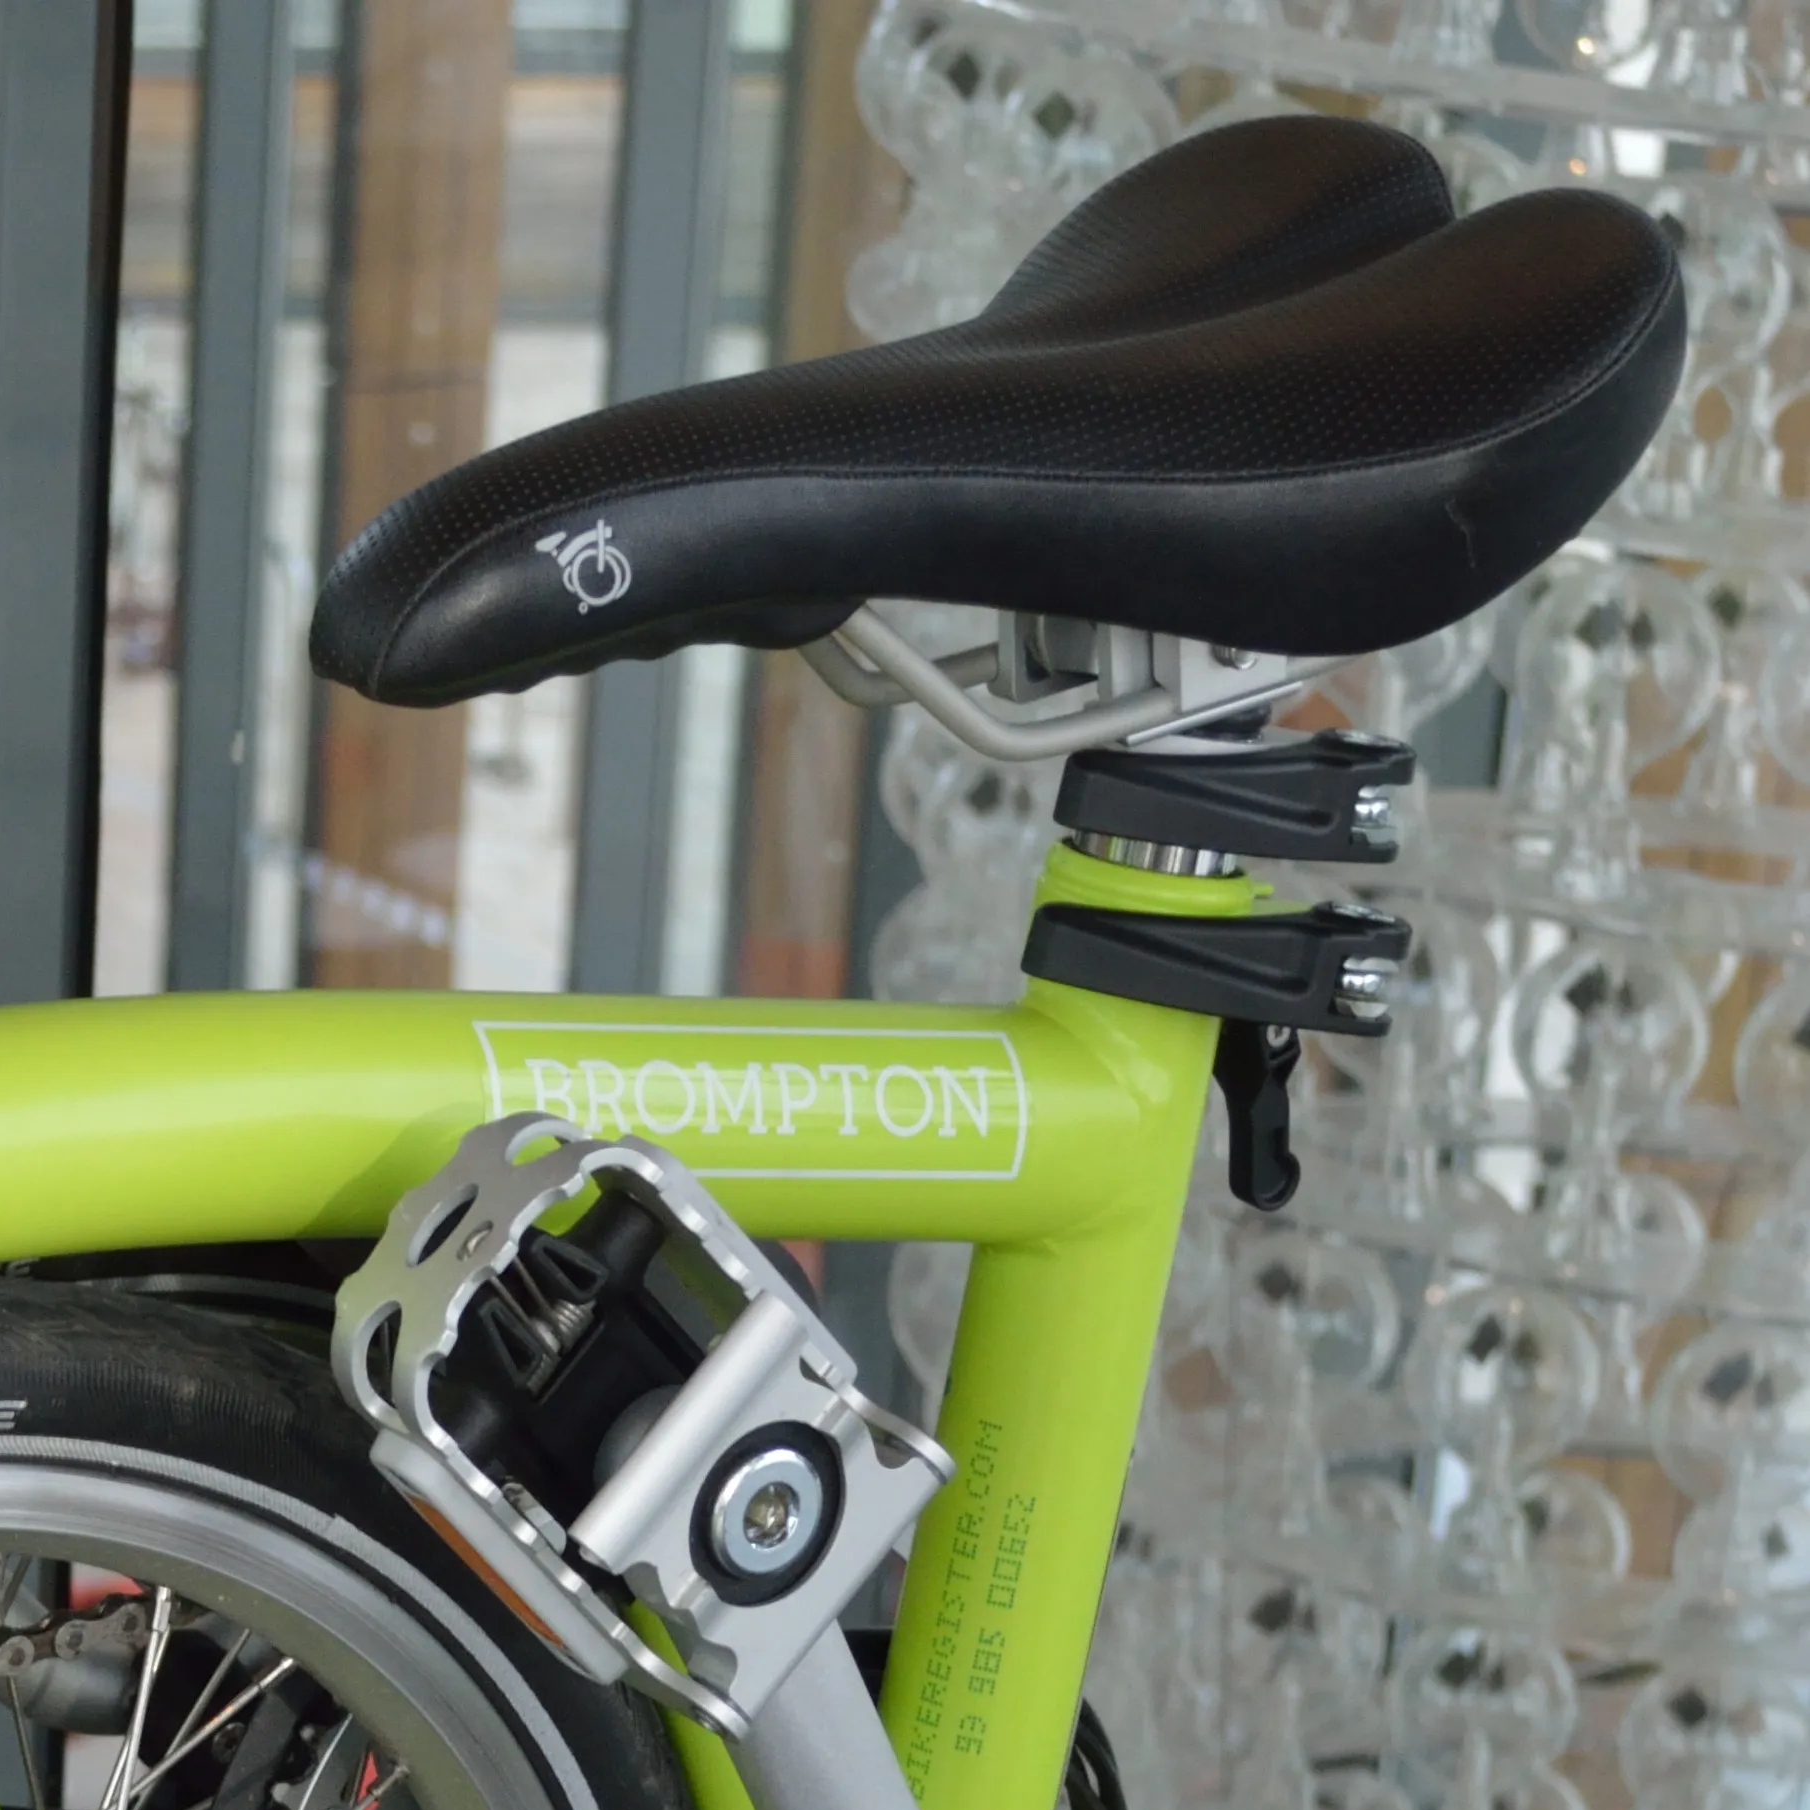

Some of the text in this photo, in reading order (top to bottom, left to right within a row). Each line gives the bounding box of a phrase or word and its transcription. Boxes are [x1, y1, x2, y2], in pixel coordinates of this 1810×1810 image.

[524, 1057, 991, 1138] BROMPTON
[968, 1627, 1006, 1695] 985
[954, 1713, 987, 1756] 93
